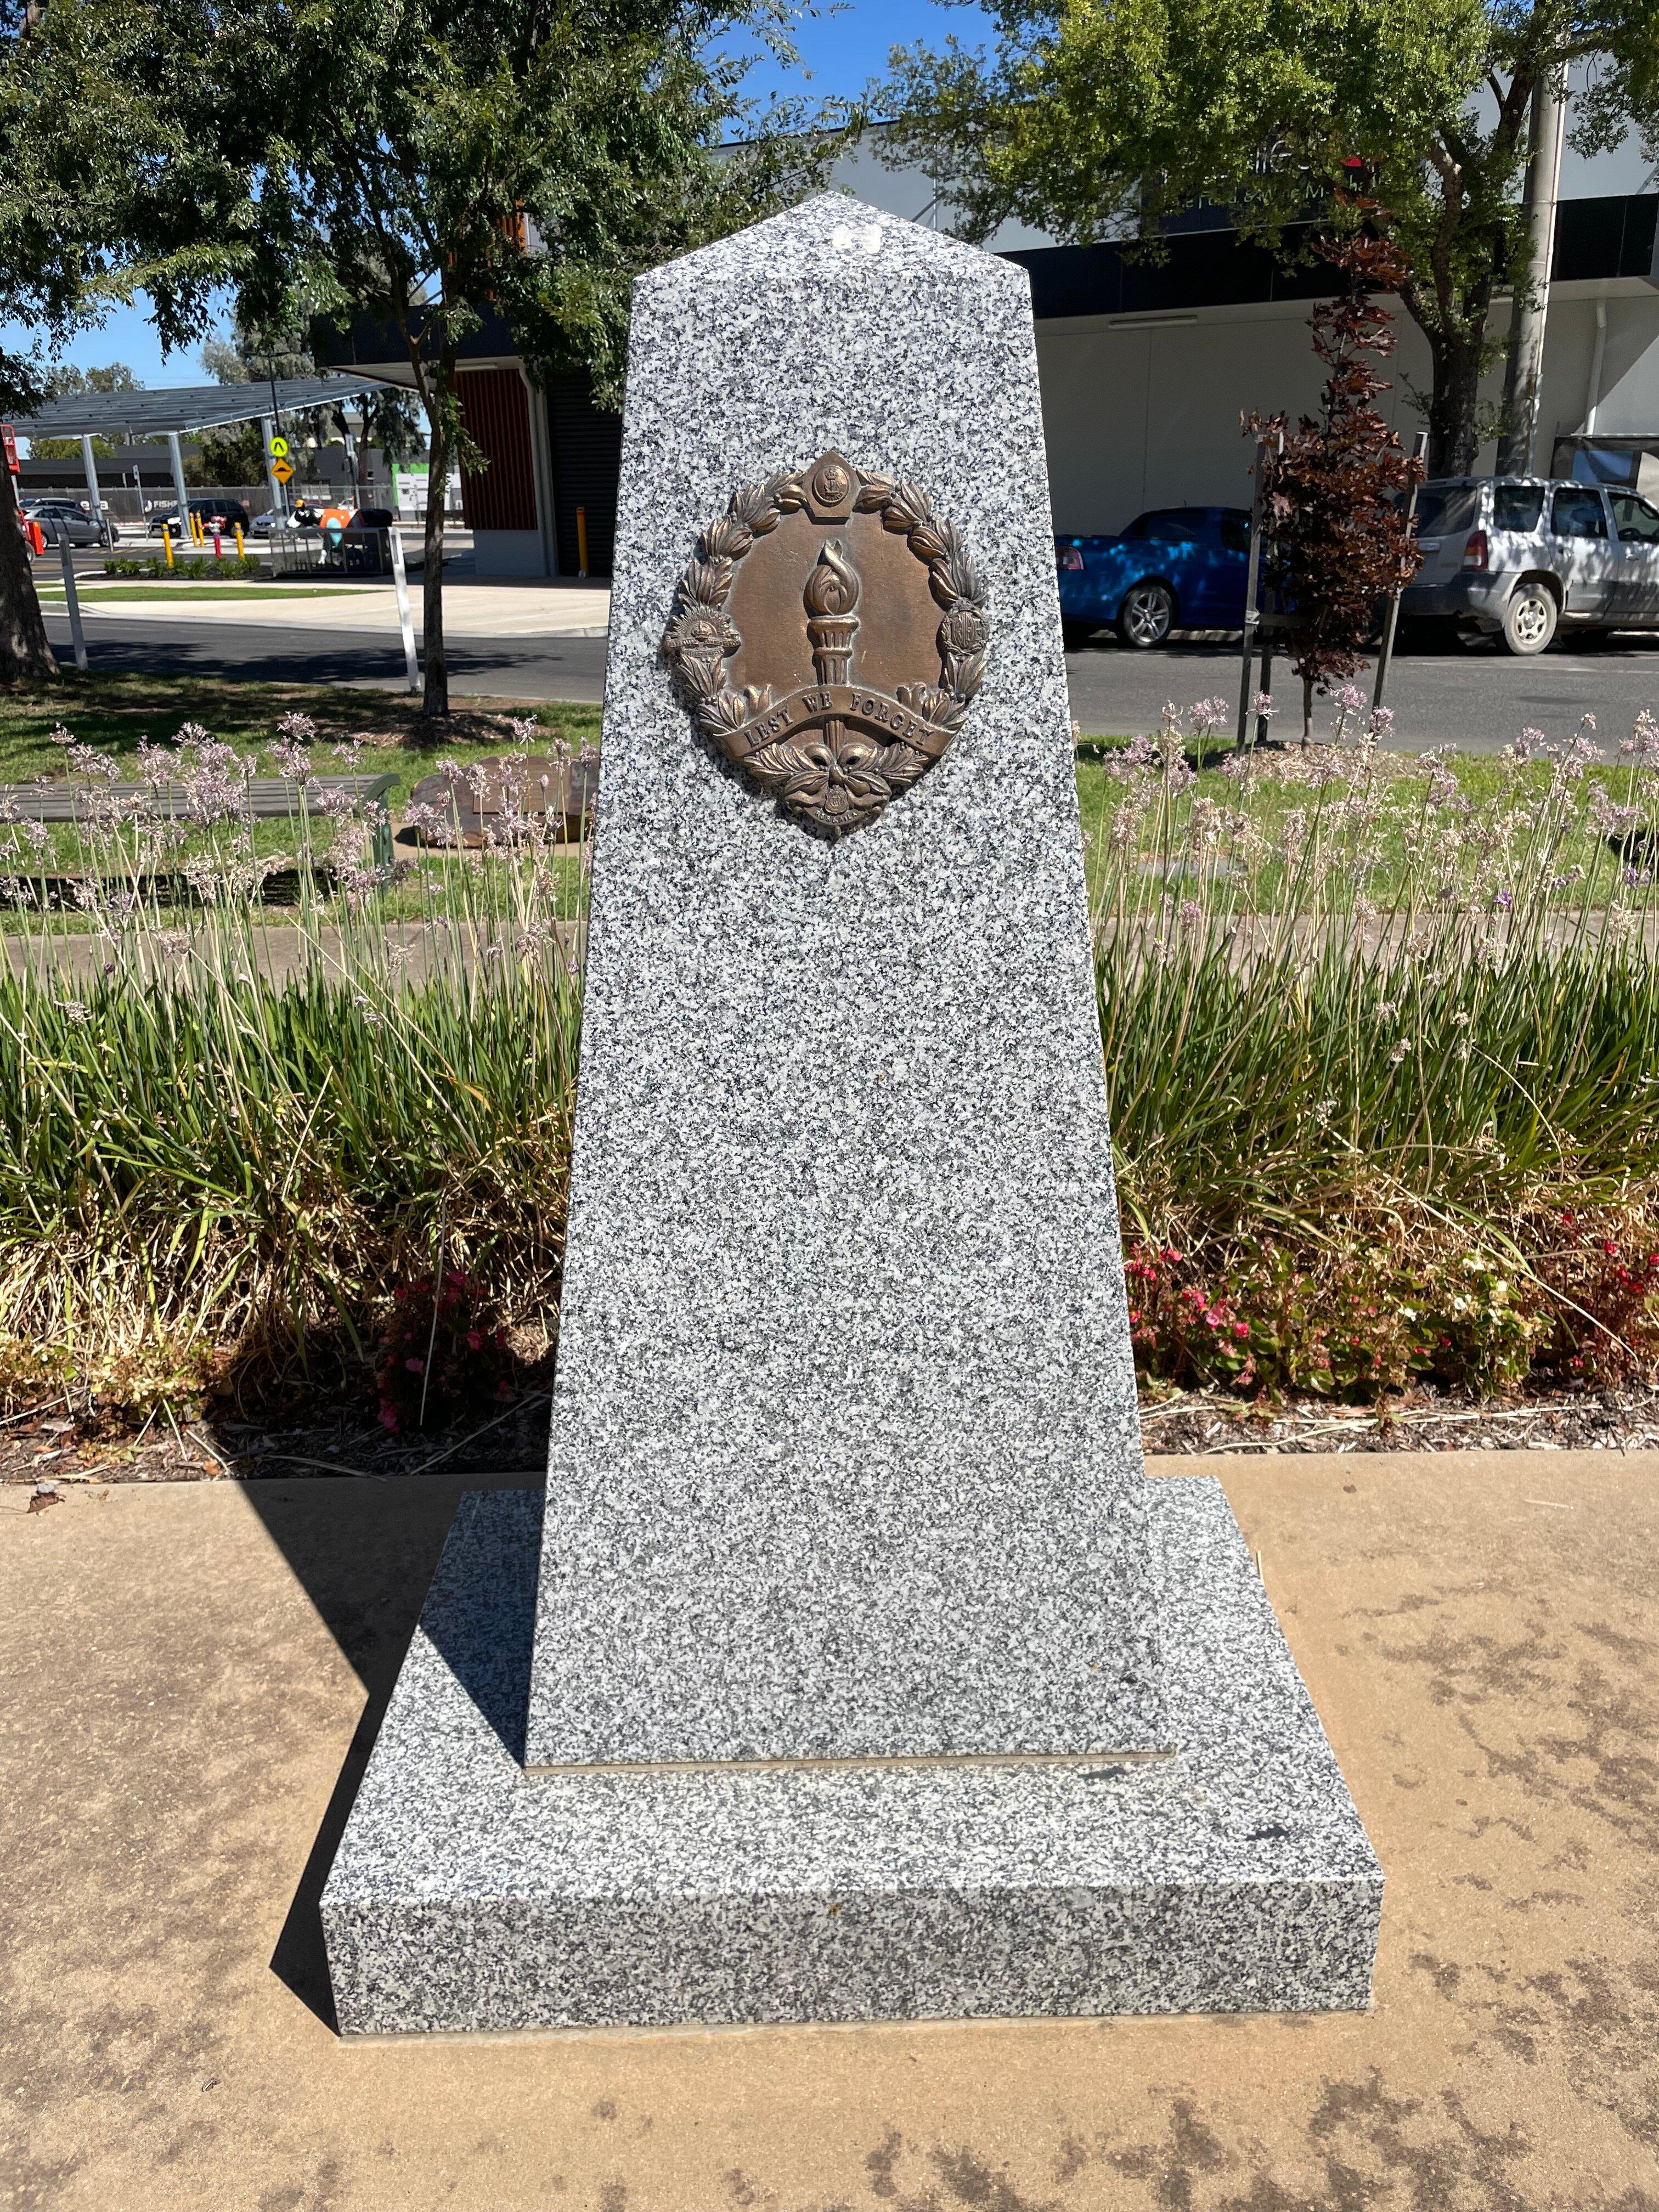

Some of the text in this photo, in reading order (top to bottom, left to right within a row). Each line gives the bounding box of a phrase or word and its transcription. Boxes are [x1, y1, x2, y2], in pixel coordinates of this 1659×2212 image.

[744, 691, 935, 747] LEST WE FORGET
